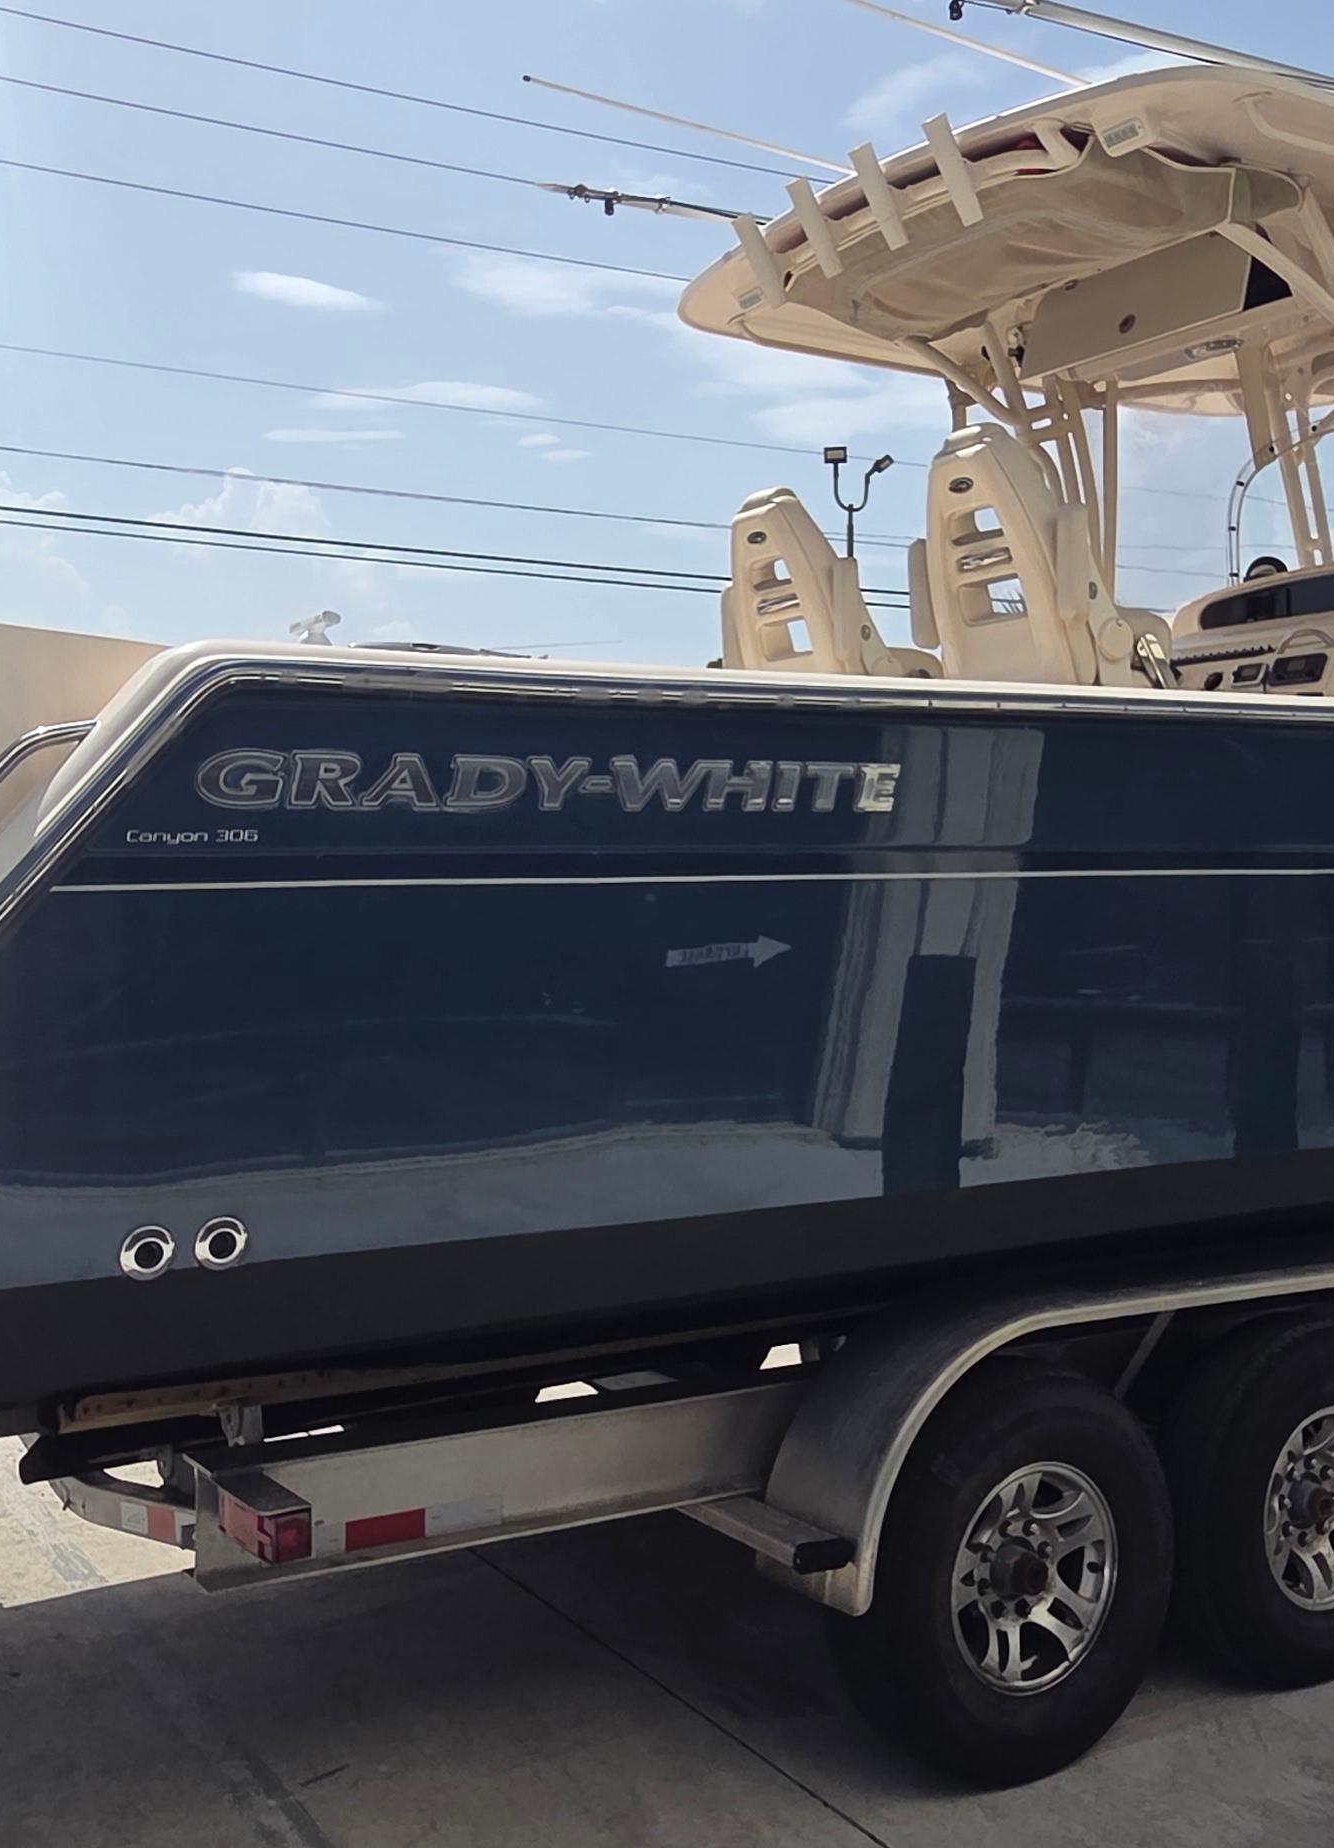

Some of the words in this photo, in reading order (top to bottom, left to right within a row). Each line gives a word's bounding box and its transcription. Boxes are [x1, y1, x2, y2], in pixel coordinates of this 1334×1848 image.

[194, 748, 902, 813] GRADY-WHITE
[126, 829, 208, 845] Canyon
[216, 829, 259, 842] 306
